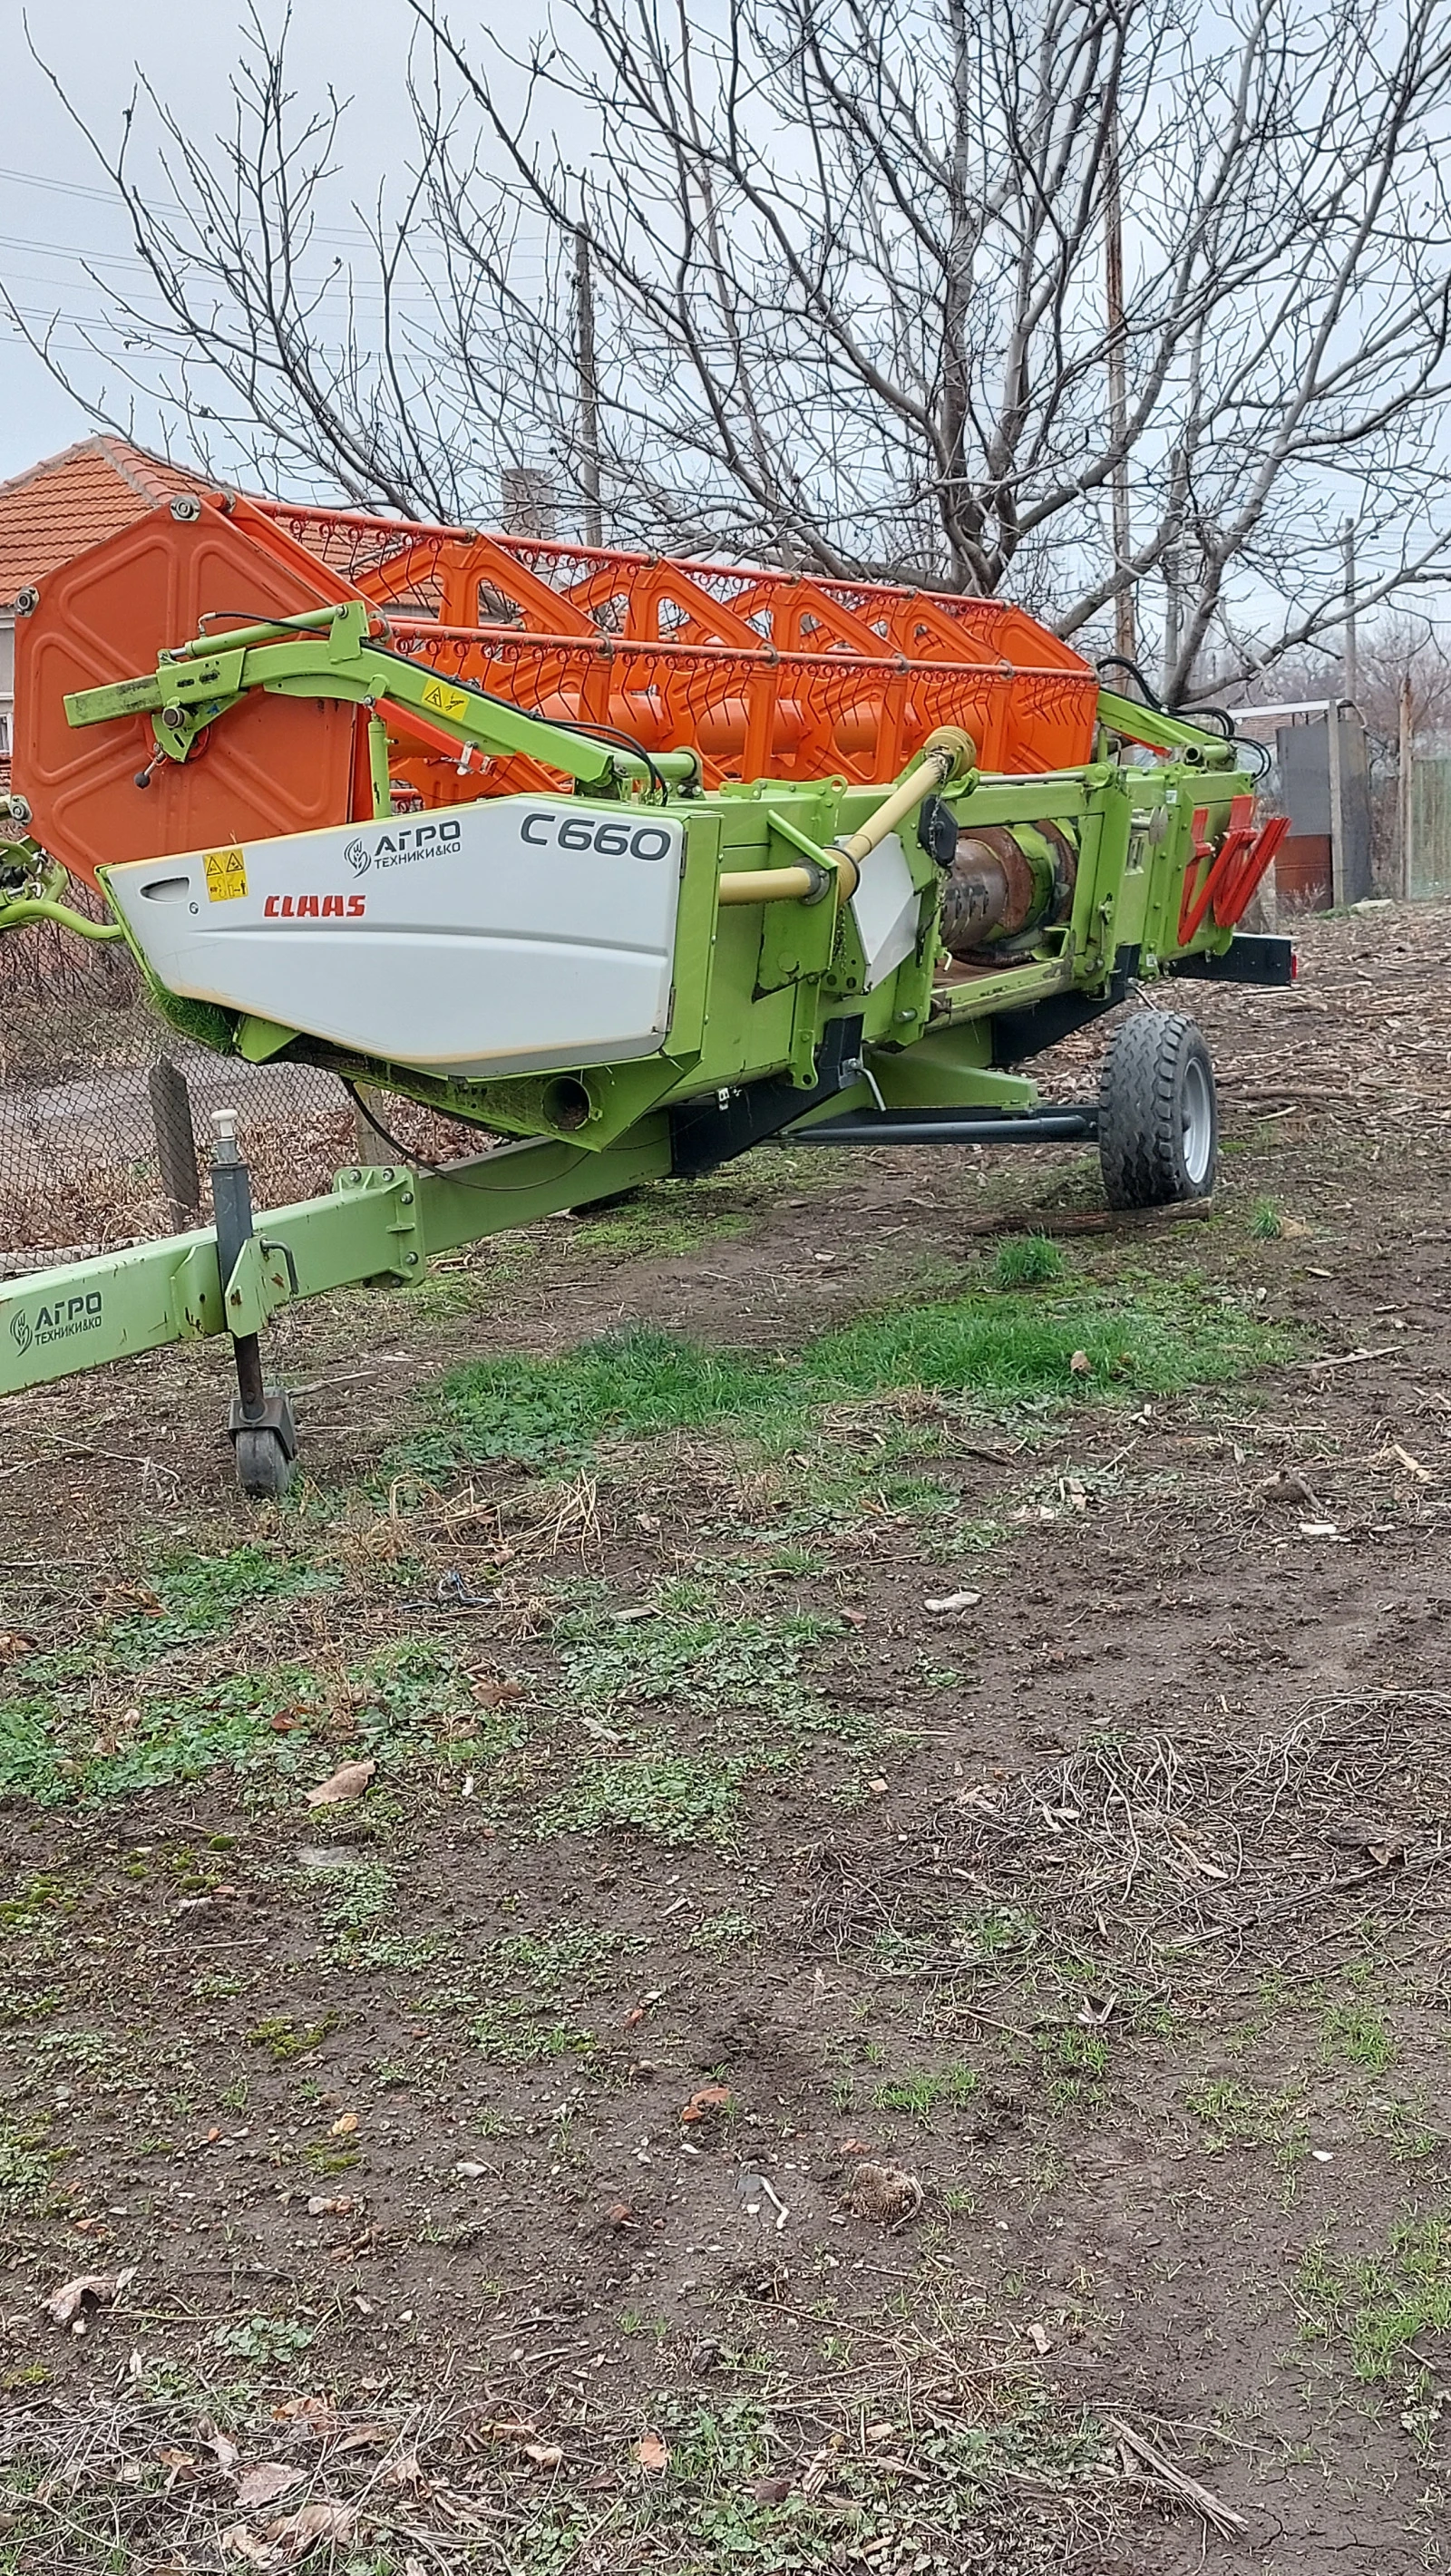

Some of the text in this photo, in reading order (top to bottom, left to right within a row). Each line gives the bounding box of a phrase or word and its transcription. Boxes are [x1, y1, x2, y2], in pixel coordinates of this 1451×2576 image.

[375, 821, 461, 856] АГРО
[375, 842, 461, 869] ТЕХНИКИ&КО
[264, 895, 365, 917] CLAAS
[34, 1291, 102, 1331] АГРО
[34, 1316, 102, 1346] ТЕХНИКИ&КО
